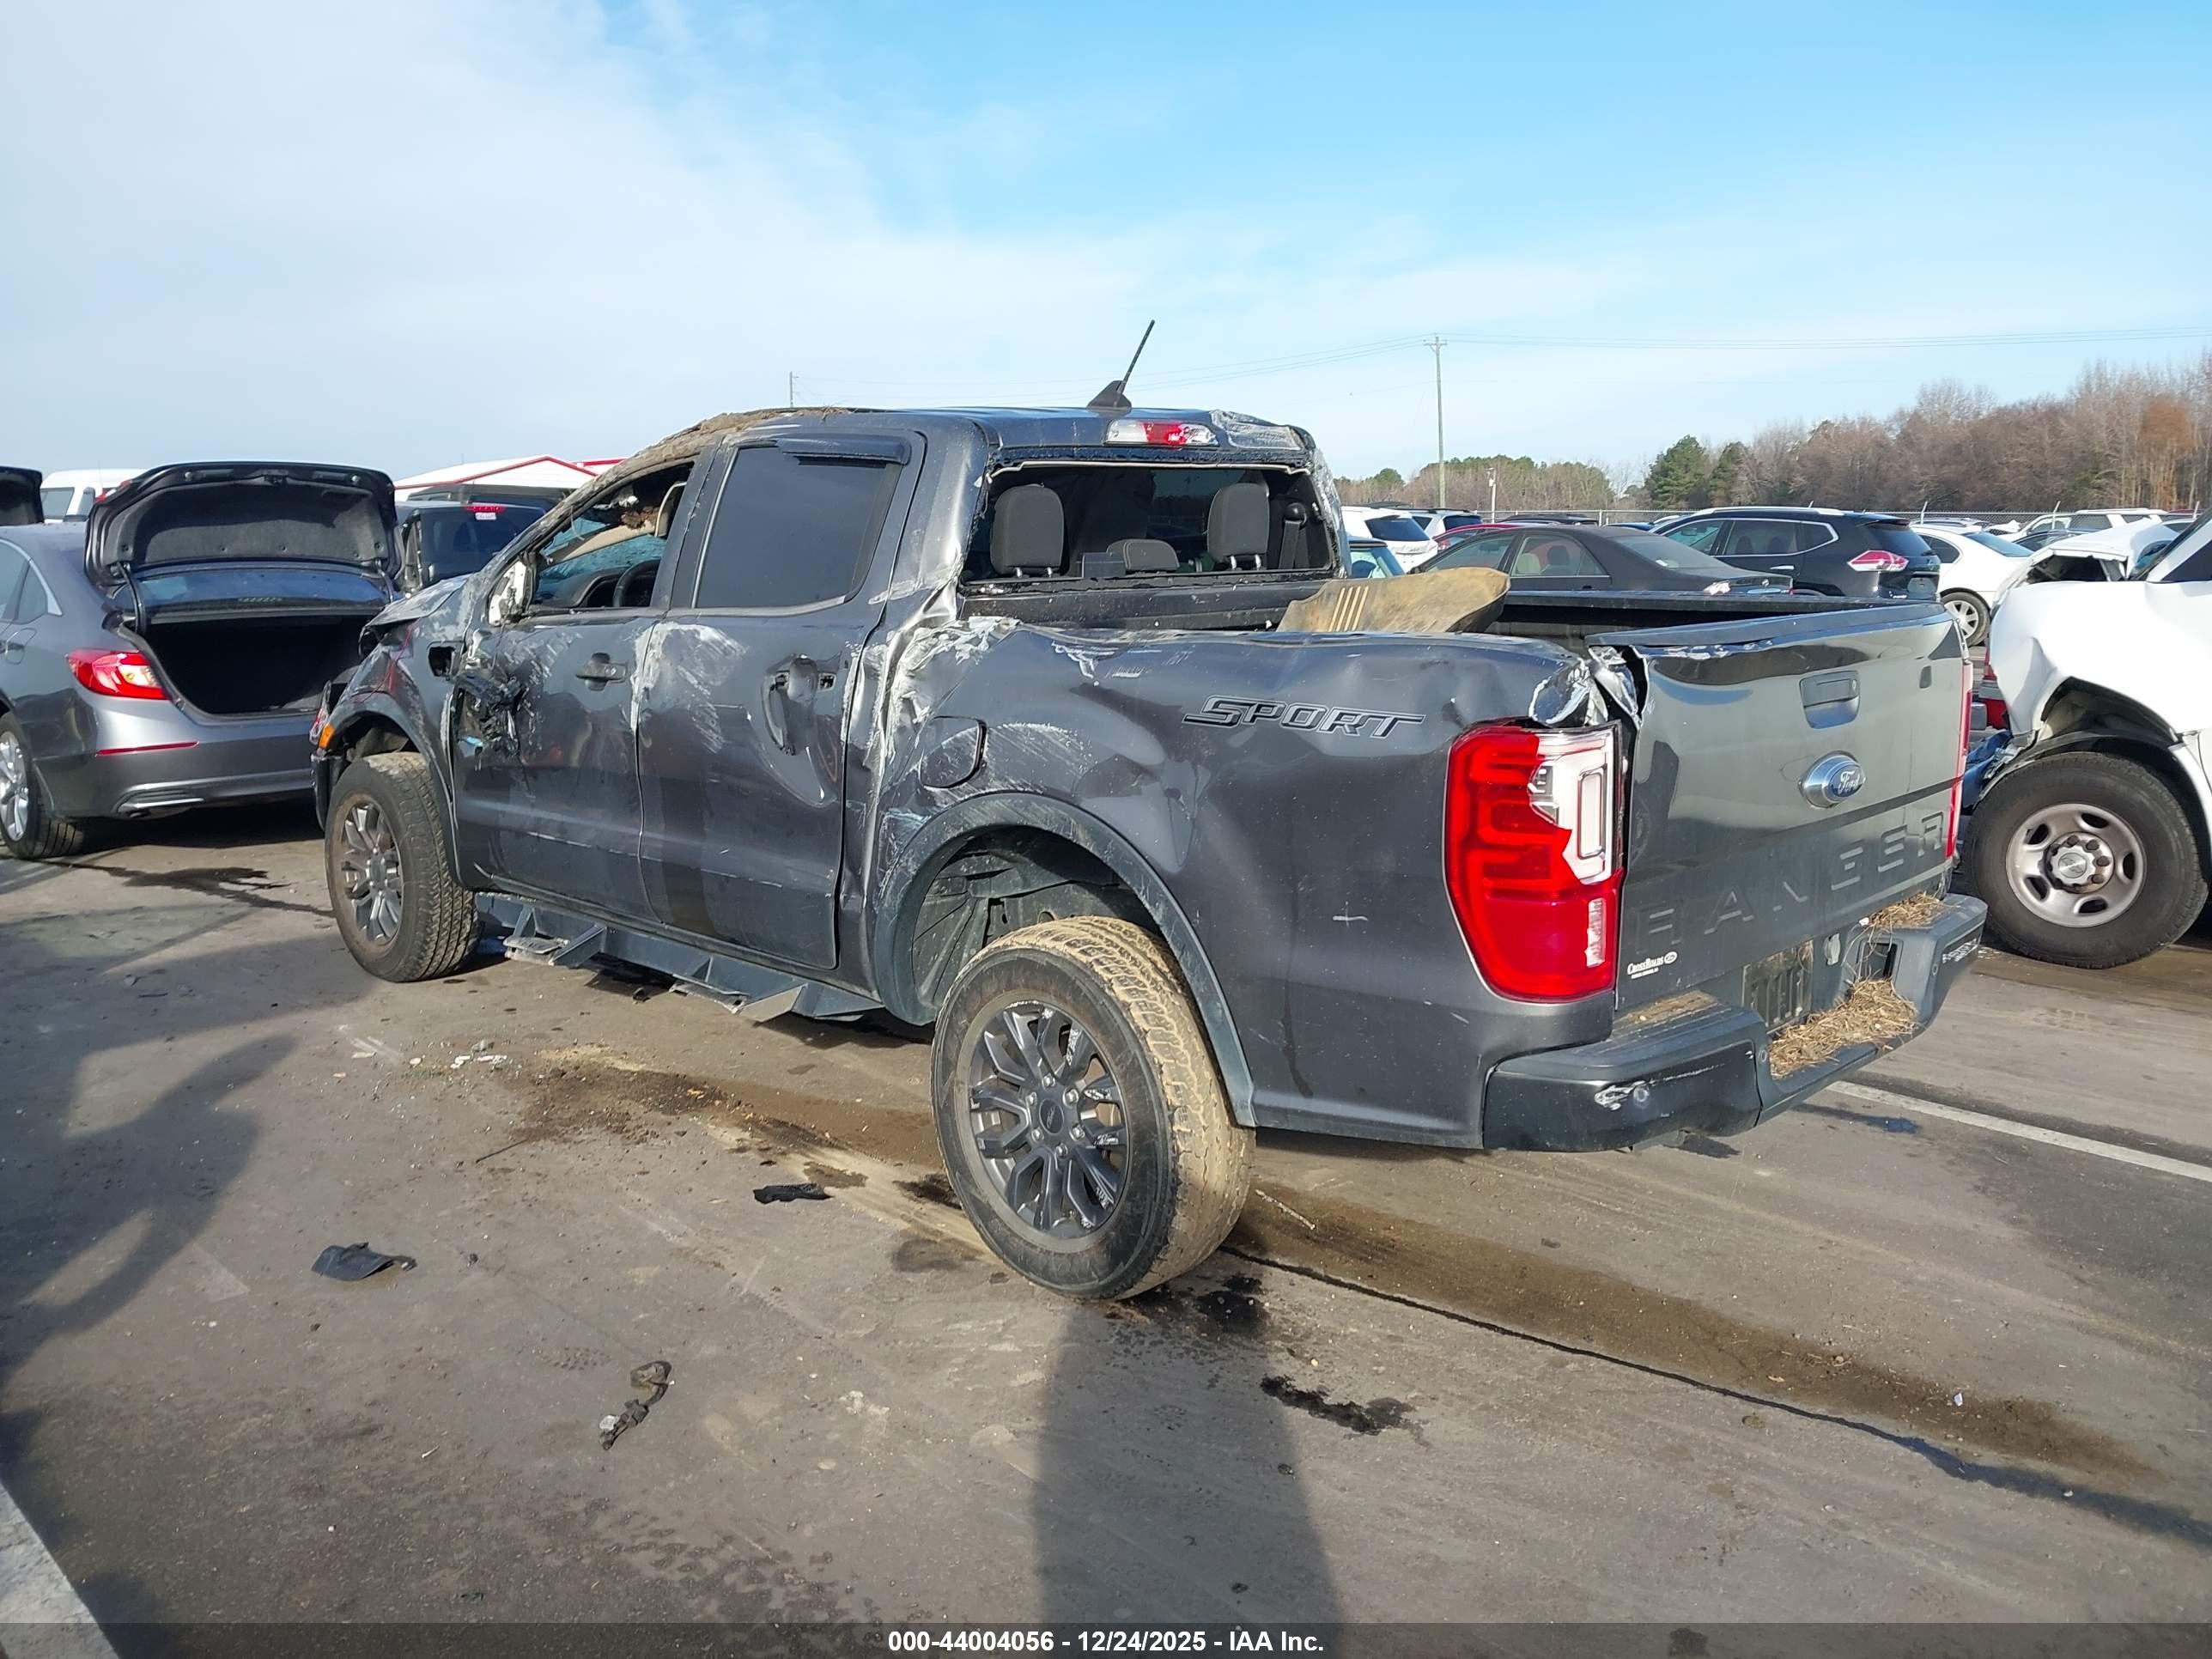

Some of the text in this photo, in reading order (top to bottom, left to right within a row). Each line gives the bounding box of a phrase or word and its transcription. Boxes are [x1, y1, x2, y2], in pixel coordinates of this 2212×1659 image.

[1182, 695, 1426, 739] SPORT
[1838, 770, 1861, 795] Ford
[1635, 811, 1944, 946] RANGER
